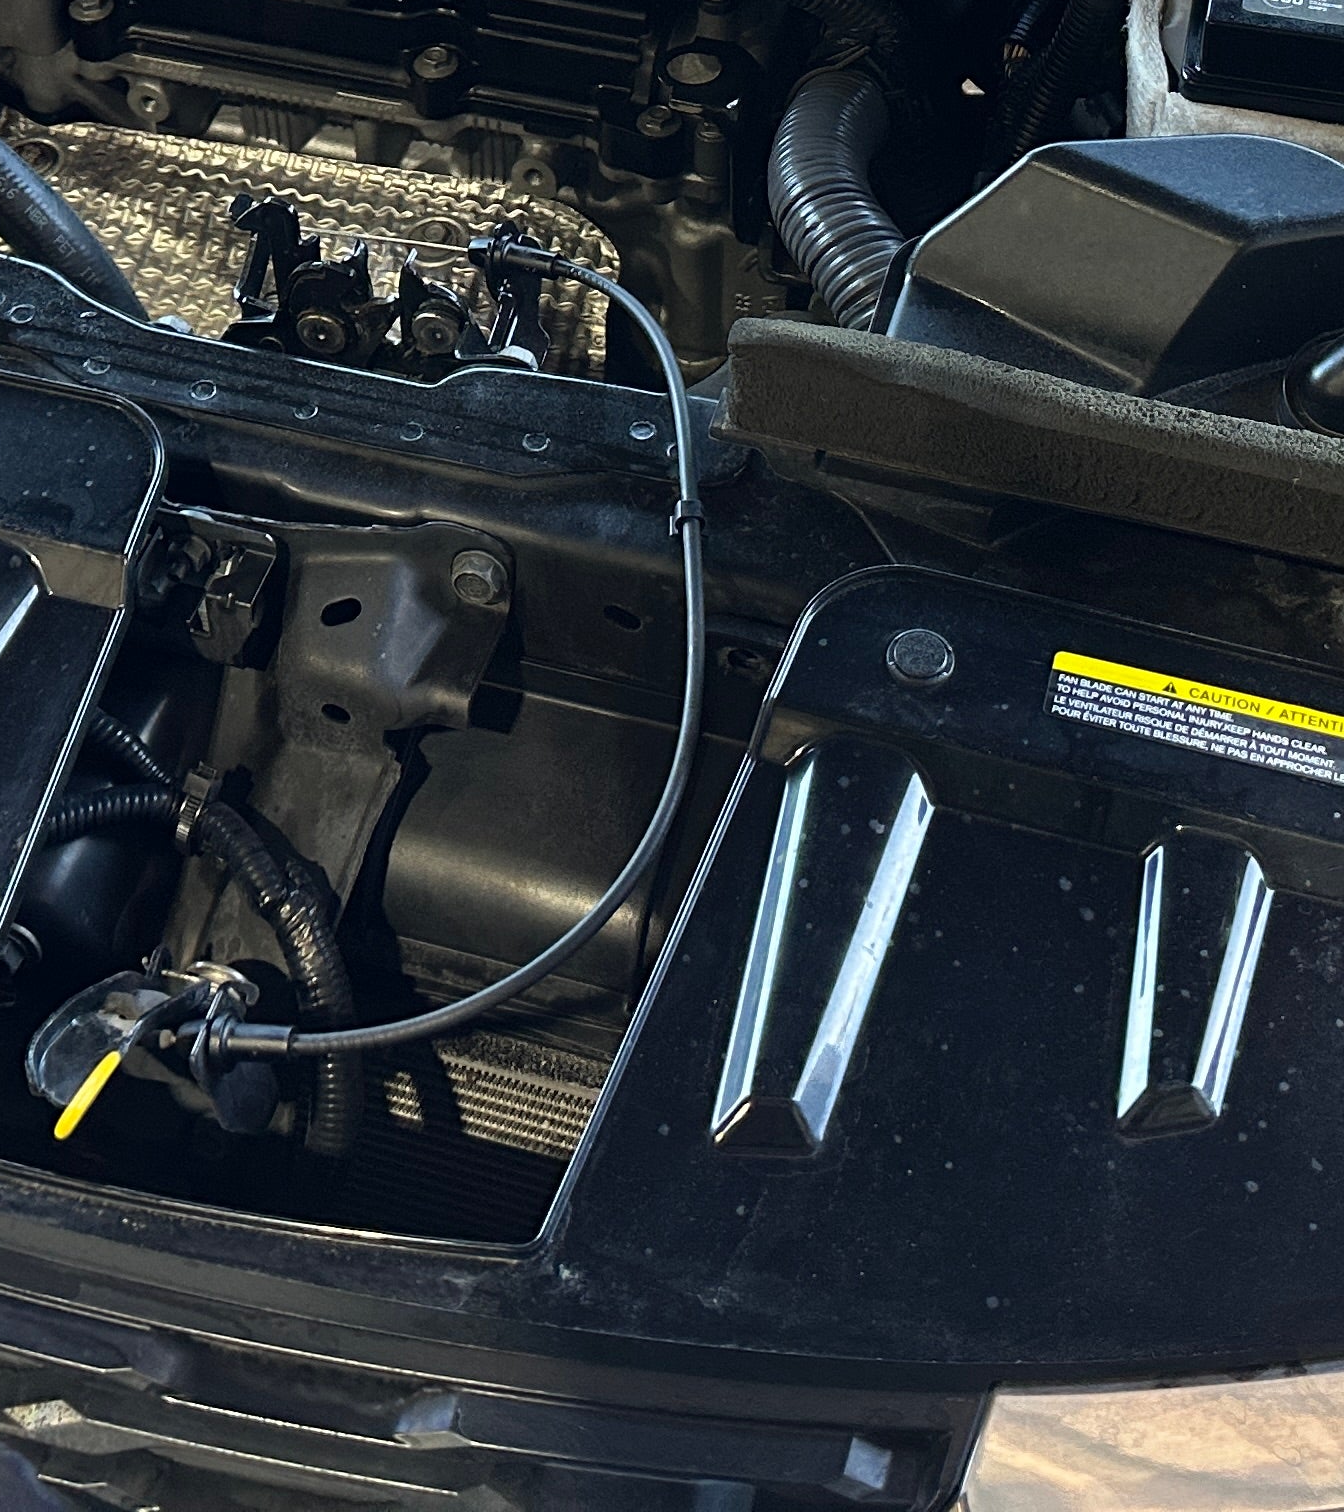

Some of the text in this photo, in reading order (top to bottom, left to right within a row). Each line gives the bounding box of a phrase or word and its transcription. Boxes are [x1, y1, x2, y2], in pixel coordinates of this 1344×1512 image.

[54, 234, 78, 260] PET
[1057, 683, 1071, 694] TO
[1071, 687, 1099, 700] HELP
[1099, 695, 1131, 709] AVOID
[1132, 702, 1187, 722] PERSONAL
[1252, 727, 1289, 746] HANDS
[1058, 674, 1078, 686] FAN
[1080, 678, 1113, 694] BLADE
[1114, 687, 1136, 699] CAN
[1138, 692, 1171, 707] START
[1171, 700, 1185, 709] AT
[1185, 703, 1208, 716] ANY
[1189, 687, 1261, 713] CAUTION
[1051, 704, 1082, 720] POUR
[1082, 710, 1117, 728] ÉVITER
[1119, 721, 1152, 737] TOUTE
[1210, 742, 1227, 755] NE
[1227, 746, 1249, 760] PAS
[1249, 752, 1265, 764] EN
[1265, 755, 1334, 780] APPROCHER
[1053, 694, 1067, 705] LE
[1068, 698, 1133, 721] VENTILATEUR
[1134, 714, 1174, 730] RISQUE
[1174, 724, 1189, 735] DE
[1190, 727, 1248, 748] DÉMARRER
[1259, 743, 1287, 758] TOUT
